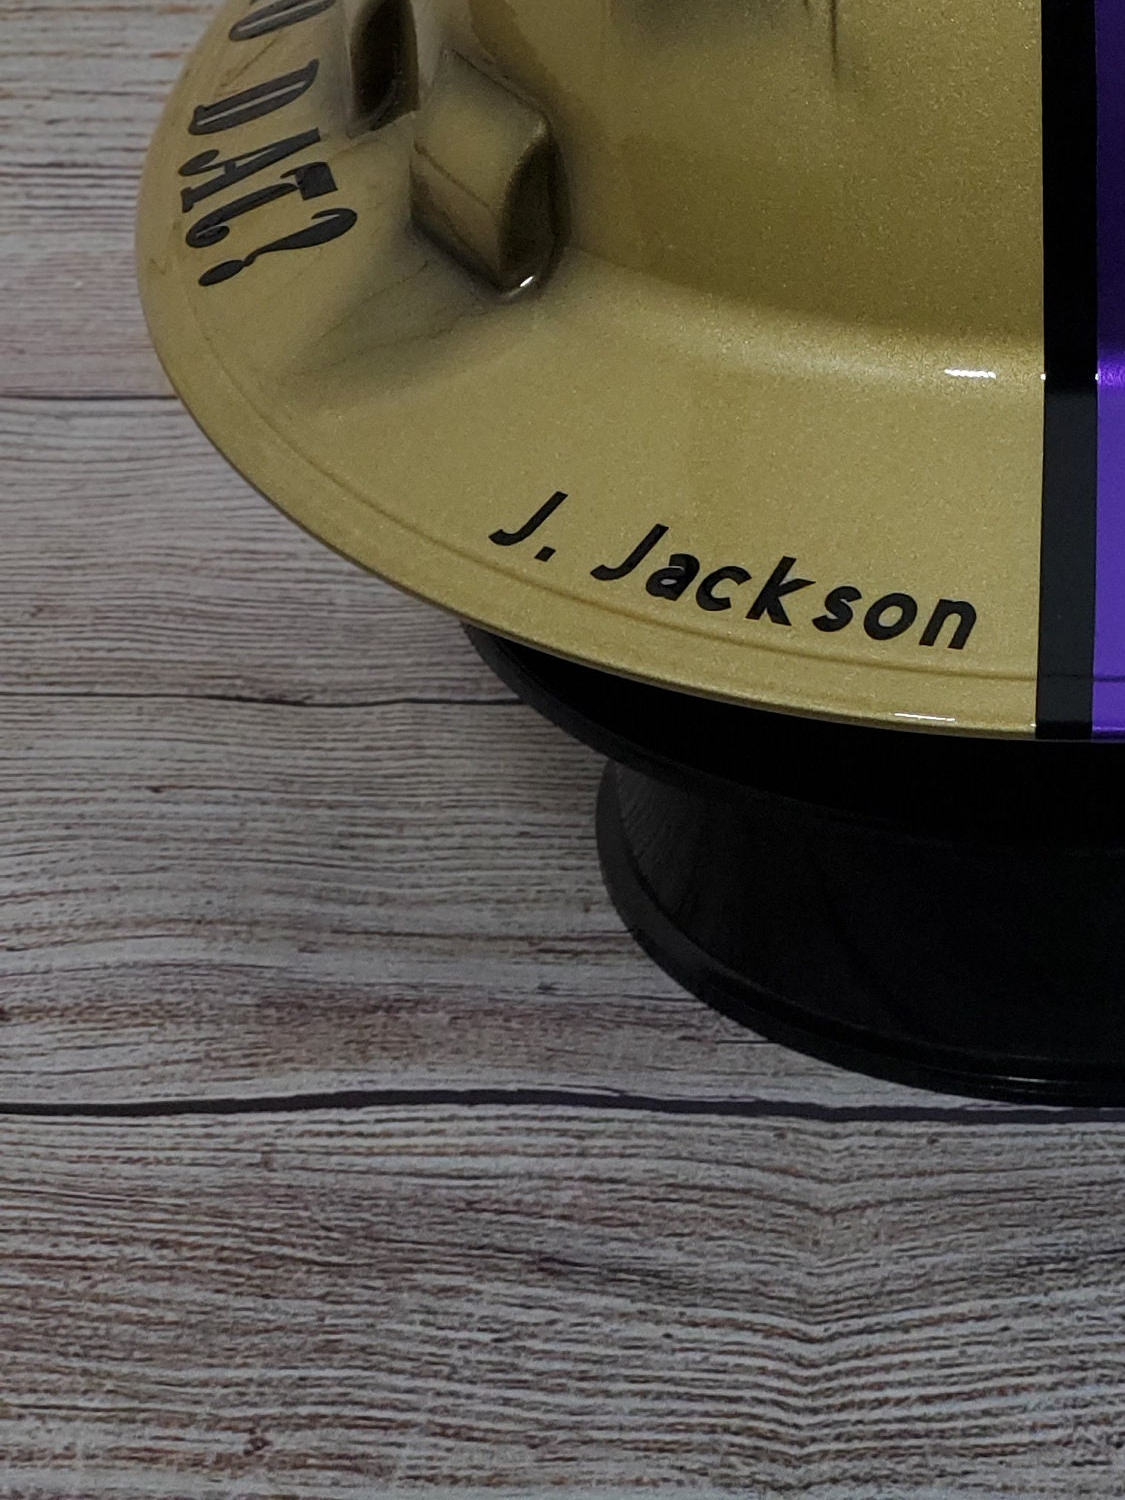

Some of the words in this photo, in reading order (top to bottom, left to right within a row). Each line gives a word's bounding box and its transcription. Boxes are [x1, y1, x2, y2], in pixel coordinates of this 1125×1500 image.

[179, 58, 358, 286] DAT?
[488, 491, 568, 562] J.
[590, 523, 978, 650] Jackson
